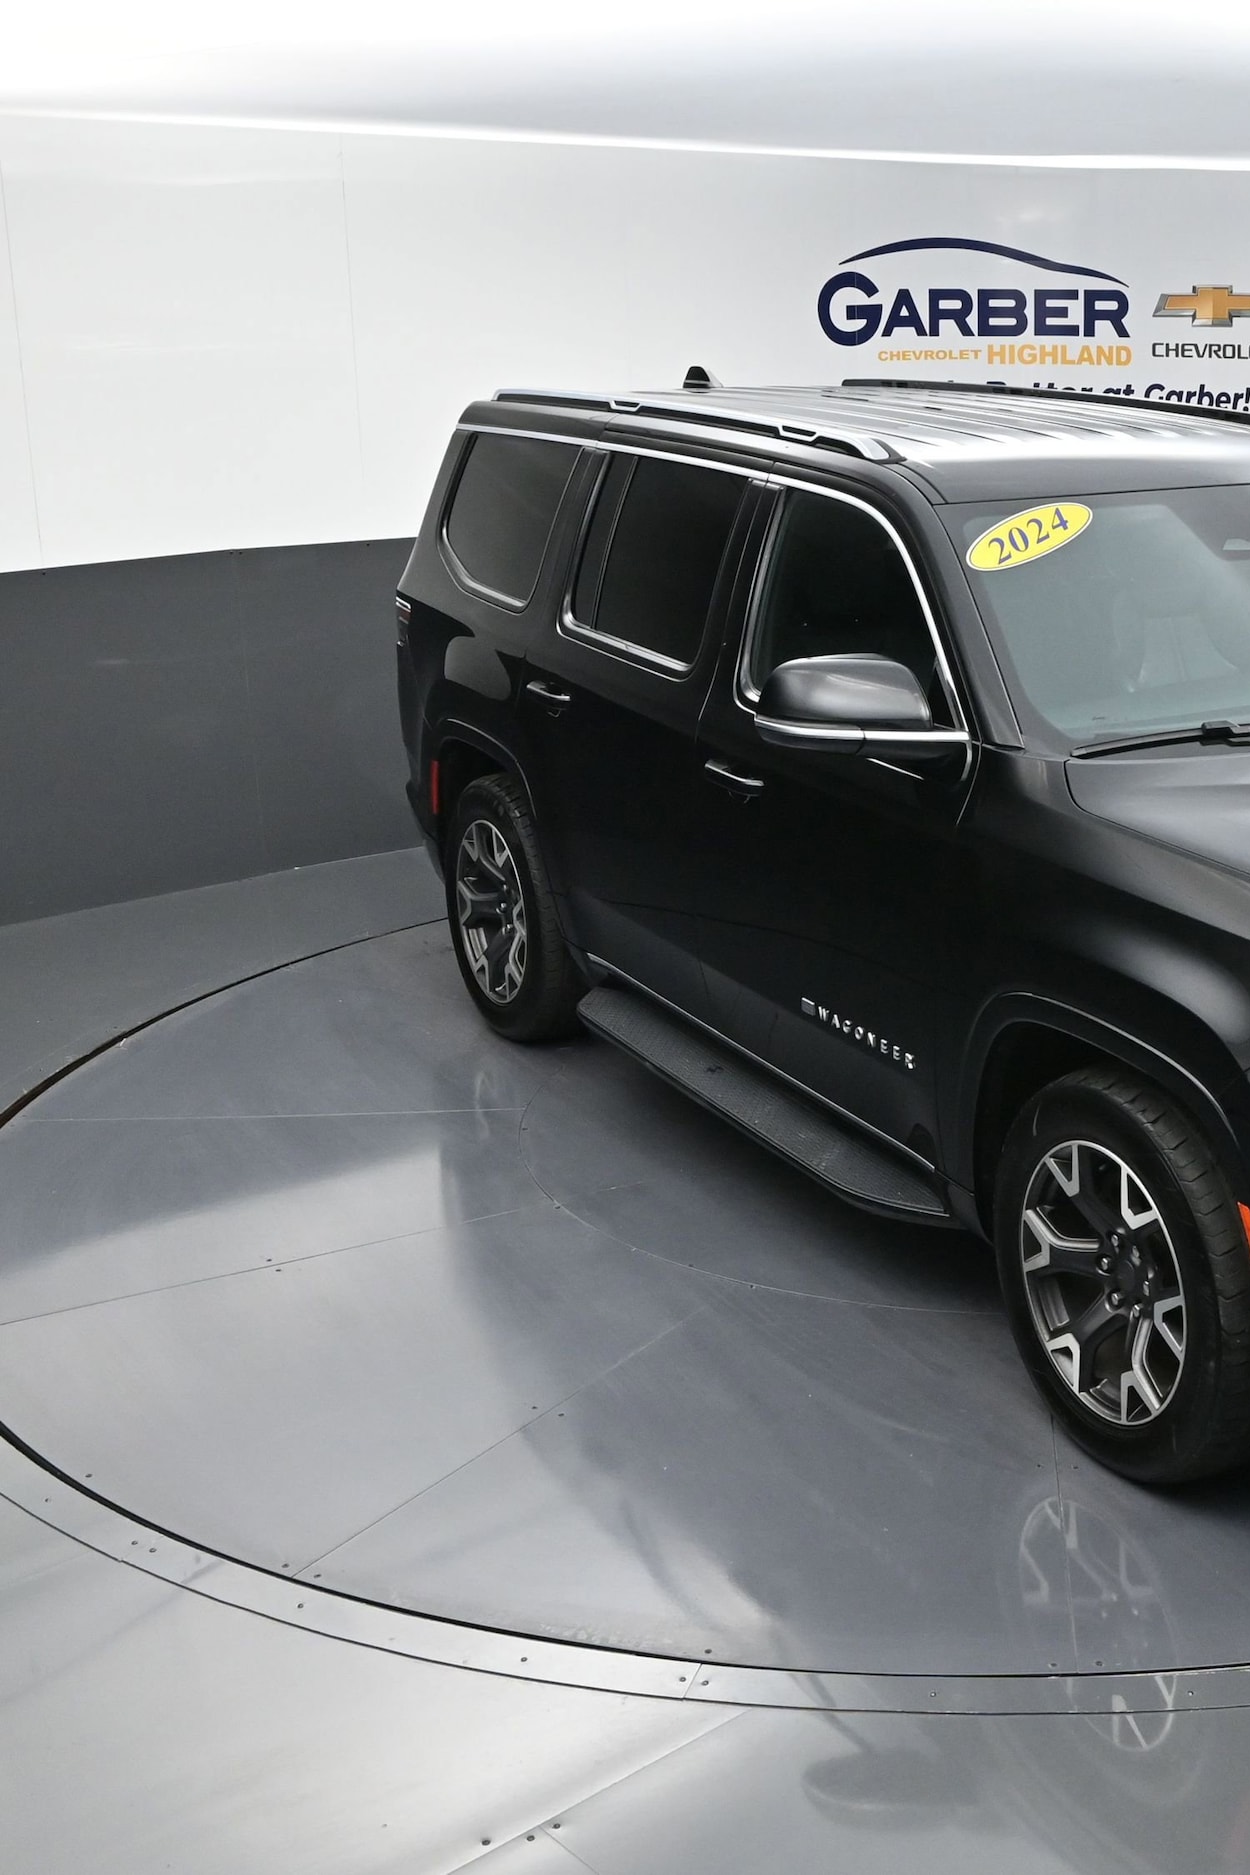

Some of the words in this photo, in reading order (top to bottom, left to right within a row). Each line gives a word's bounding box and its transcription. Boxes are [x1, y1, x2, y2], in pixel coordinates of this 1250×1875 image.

[818, 271, 1130, 346] GARBER
[878, 349, 982, 361] CHEVROLET
[987, 344, 1132, 366] HIGHLAND
[988, 507, 1068, 565] 2024
[818, 1006, 916, 1069] WAGONEER
